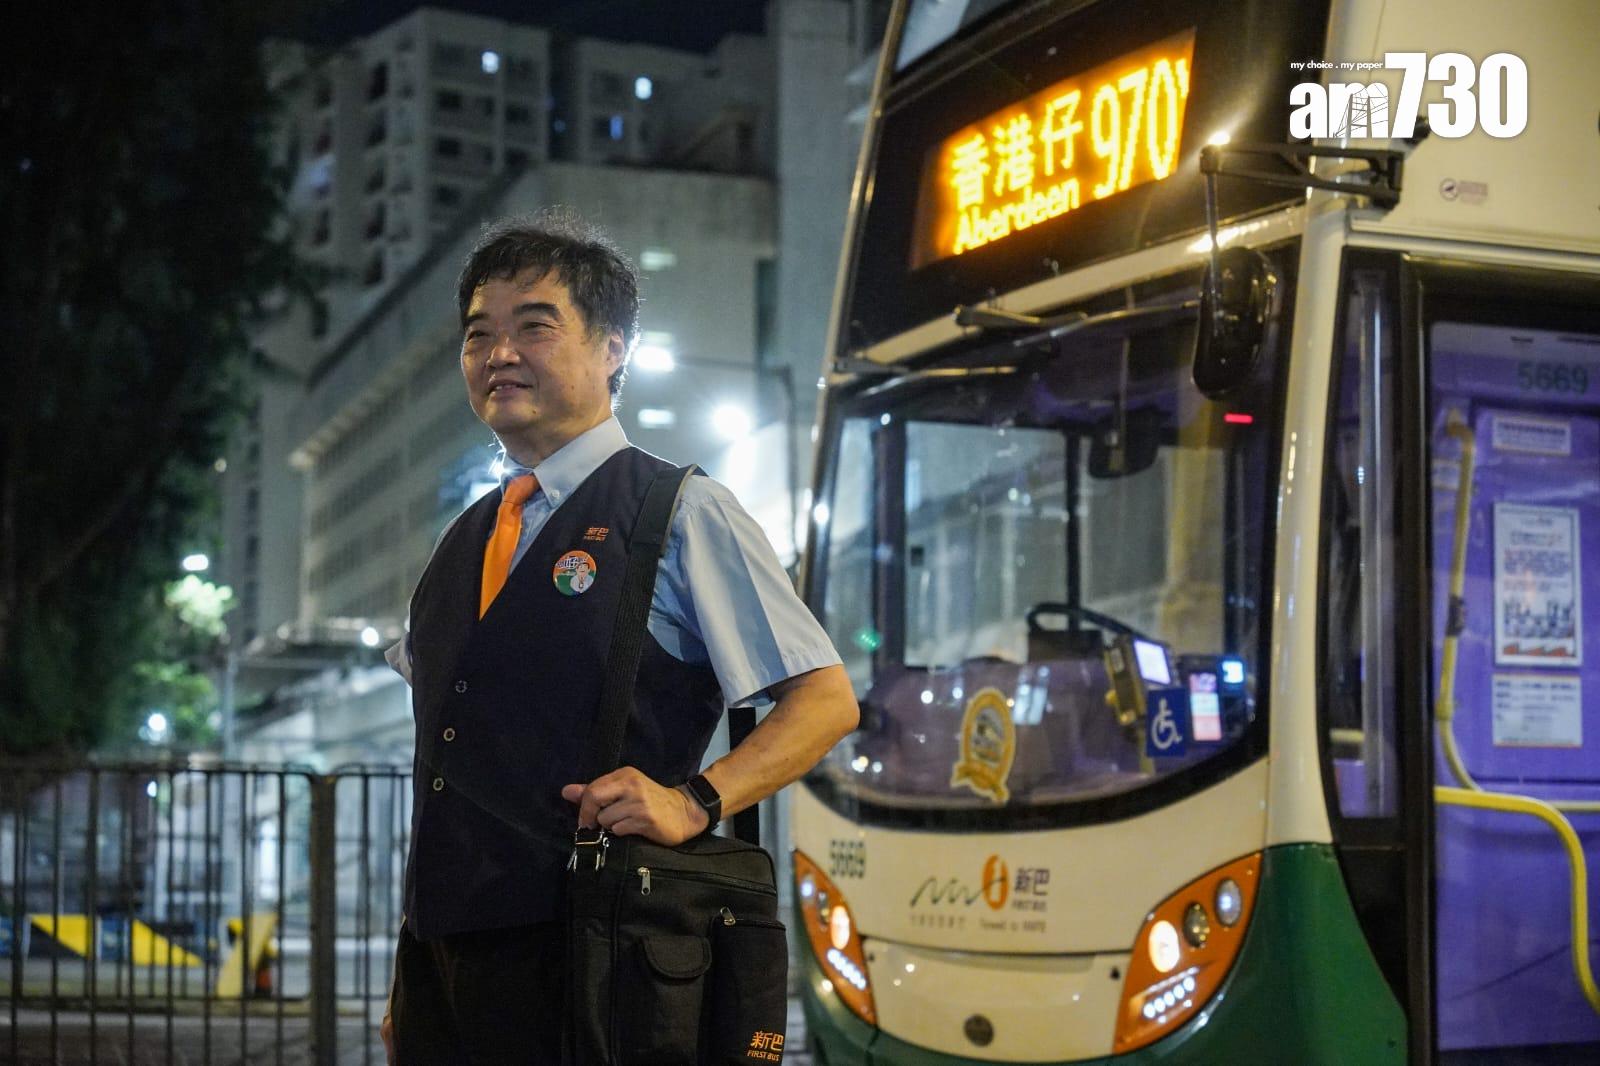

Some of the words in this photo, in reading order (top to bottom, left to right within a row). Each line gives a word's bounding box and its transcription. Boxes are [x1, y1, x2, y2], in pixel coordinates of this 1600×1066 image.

[952, 89, 1083, 211] 香港仔
[1091, 59, 1190, 200] 970
[953, 178, 1080, 255] Aberdeen
[1518, 361, 1588, 394] 5669
[1014, 868, 1050, 897] 新巴
[747, 1050, 766, 1058] FIRST
[767, 1053, 780, 1061] BUS
[750, 1031, 784, 1051] 新巴
